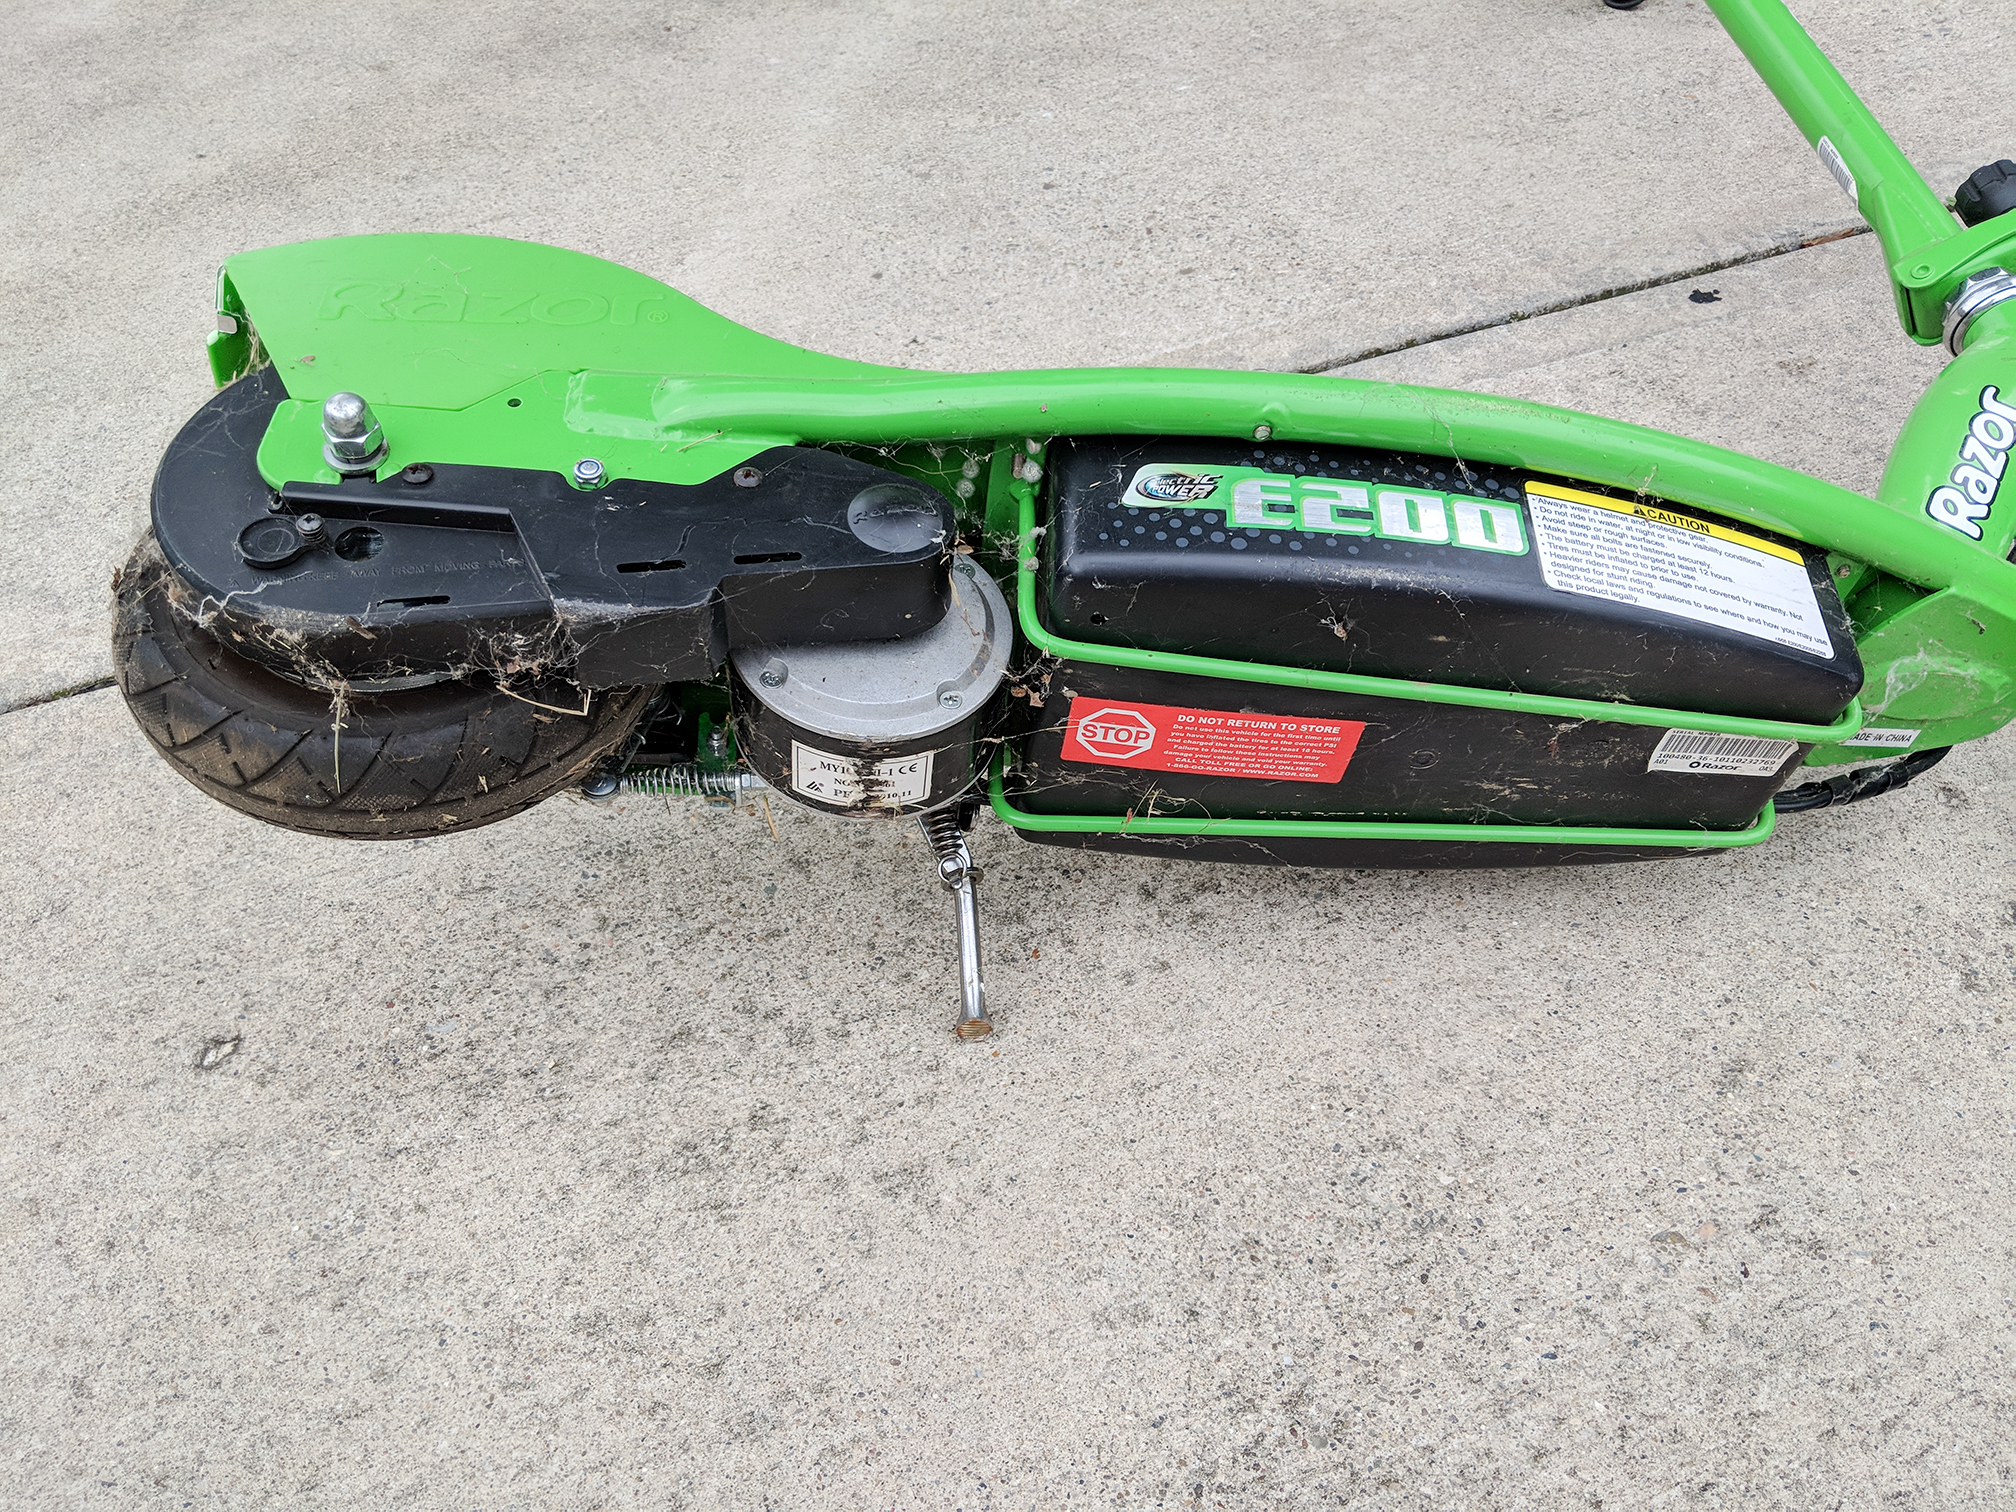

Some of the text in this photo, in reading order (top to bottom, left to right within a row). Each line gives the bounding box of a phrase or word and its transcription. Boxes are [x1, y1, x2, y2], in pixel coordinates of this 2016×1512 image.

[1926, 385, 2016, 541] Razor
[1152, 484, 1218, 499] POWER
[1232, 479, 1526, 553] E200
[1538, 497, 1568, 509] Always
[1570, 505, 1590, 514] wear
[1600, 511, 1629, 522] helmet
[1649, 522, 1686, 537] protective
[1689, 534, 1708, 543] gear.
[1646, 508, 1710, 534] CAUTION
[1542, 516, 1565, 525] Avoid
[1568, 520, 1590, 531] steep
[1605, 528, 1628, 539] rough
[1631, 533, 1667, 548] surfaces.
[1544, 524, 1567, 534] Make
[1570, 530, 1588, 538] sure
[1603, 536, 1622, 546] bolts
[1640, 545, 1675, 559] fastened
[1678, 554, 1712, 568] securely.
[1598, 520, 1623, 530] water,
[1636, 528, 1655, 538] night
[1677, 538, 1690, 546] low
[1692, 542, 1722, 556] visibility
[1725, 551, 1764, 568] conditions.
[391, 566, 427, 575] FROM
[434, 561, 480, 572] MOVING
[1545, 533, 1562, 542] The
[1565, 537, 1594, 549] battery
[1597, 545, 1618, 553] must
[1620, 547, 1630, 556] be
[1632, 552, 1665, 565] charged
[1678, 562, 1697, 573] least
[1711, 572, 1735, 583] hours.
[1547, 542, 1568, 551] Tires
[1572, 548, 1592, 556] must
[1608, 554, 1637, 566] inflated
[1651, 565, 1668, 575] prior
[1681, 572, 1698, 581] use.
[1550, 551, 1803, 621] Heavier riders may cause damage not covered by warranty. Not
[1551, 561, 1655, 588] designed for stunt riding.
[1558, 580, 1640, 602] this product legally.
[1554, 570, 1581, 581] Check
[1584, 575, 1604, 585] local
[1606, 580, 1626, 590] laws
[1628, 586, 1644, 594] and
[1647, 590, 1692, 605] regulations
[1704, 604, 1718, 612] see
[1720, 609, 1745, 620] where
[1747, 616, 1761, 624] and
[1764, 620, 1780, 630] how
[1781, 625, 1795, 636] you
[1797, 630, 1813, 642] may
[1814, 636, 1827, 646] use
[1082, 724, 1150, 744] STOP
[1227, 719, 1277, 729] RETURN
[1299, 725, 1340, 734] STORE
[1873, 733, 1884, 742] IN
[1886, 734, 1912, 742] CHINA
[1242, 769, 1318, 778] WWW.RAZOR.COM
[1702, 762, 1742, 771] Razor
